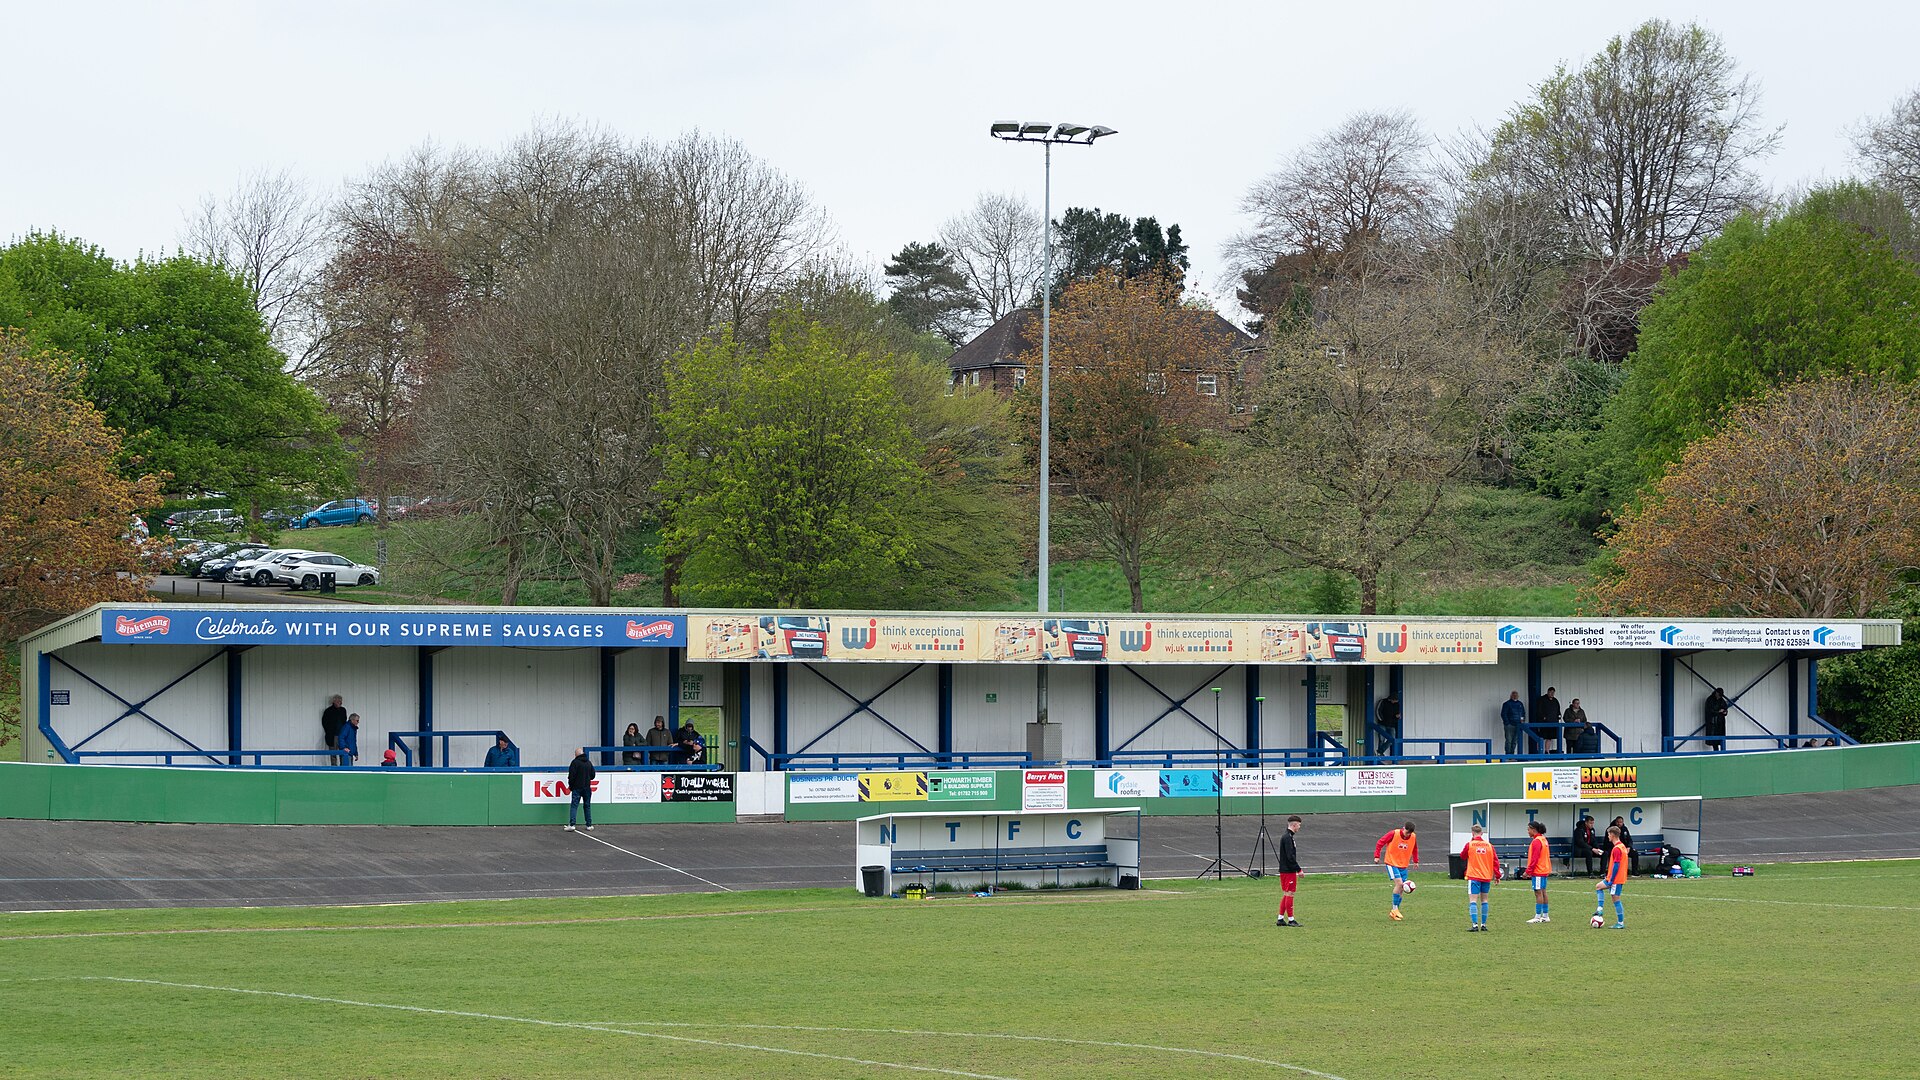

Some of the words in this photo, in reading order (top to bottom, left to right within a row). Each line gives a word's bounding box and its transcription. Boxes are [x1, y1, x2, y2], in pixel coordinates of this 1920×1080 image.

[118, 620, 168, 634] Blakemans
[196, 616, 277, 640] Celebrate
[286, 623, 337, 636] WITH
[348, 623, 390, 636] OUR
[400, 624, 492, 636] SUPREME
[503, 624, 604, 637] SAUSAGES
[628, 624, 672, 638] Blakemans
[842, 618, 876, 650] wj
[883, 626, 906, 636] think
[910, 626, 964, 639] exceptional
[1120, 622, 1151, 652] wj
[1157, 629, 1179, 638] think
[1182, 629, 1232, 640] exceptional
[1378, 624, 1407, 653] wj
[1412, 630, 1434, 639] think
[1436, 630, 1482, 641] exceptional
[891, 642, 912, 651] wj.uk
[1165, 644, 1184, 653] wj.uk
[1420, 645, 1438, 654] wj.uk
[683, 682, 700, 690] FIRE
[683, 692, 700, 700] EXIT
[1581, 767, 1636, 782] BROWN
[1472, 810, 1487, 828] N
[1526, 809, 1538, 822] T
[1630, 807, 1643, 825] C
[880, 823, 896, 844] N
[945, 822, 960, 842] T
[1008, 821, 1021, 840] F
[1066, 820, 1082, 839] C
